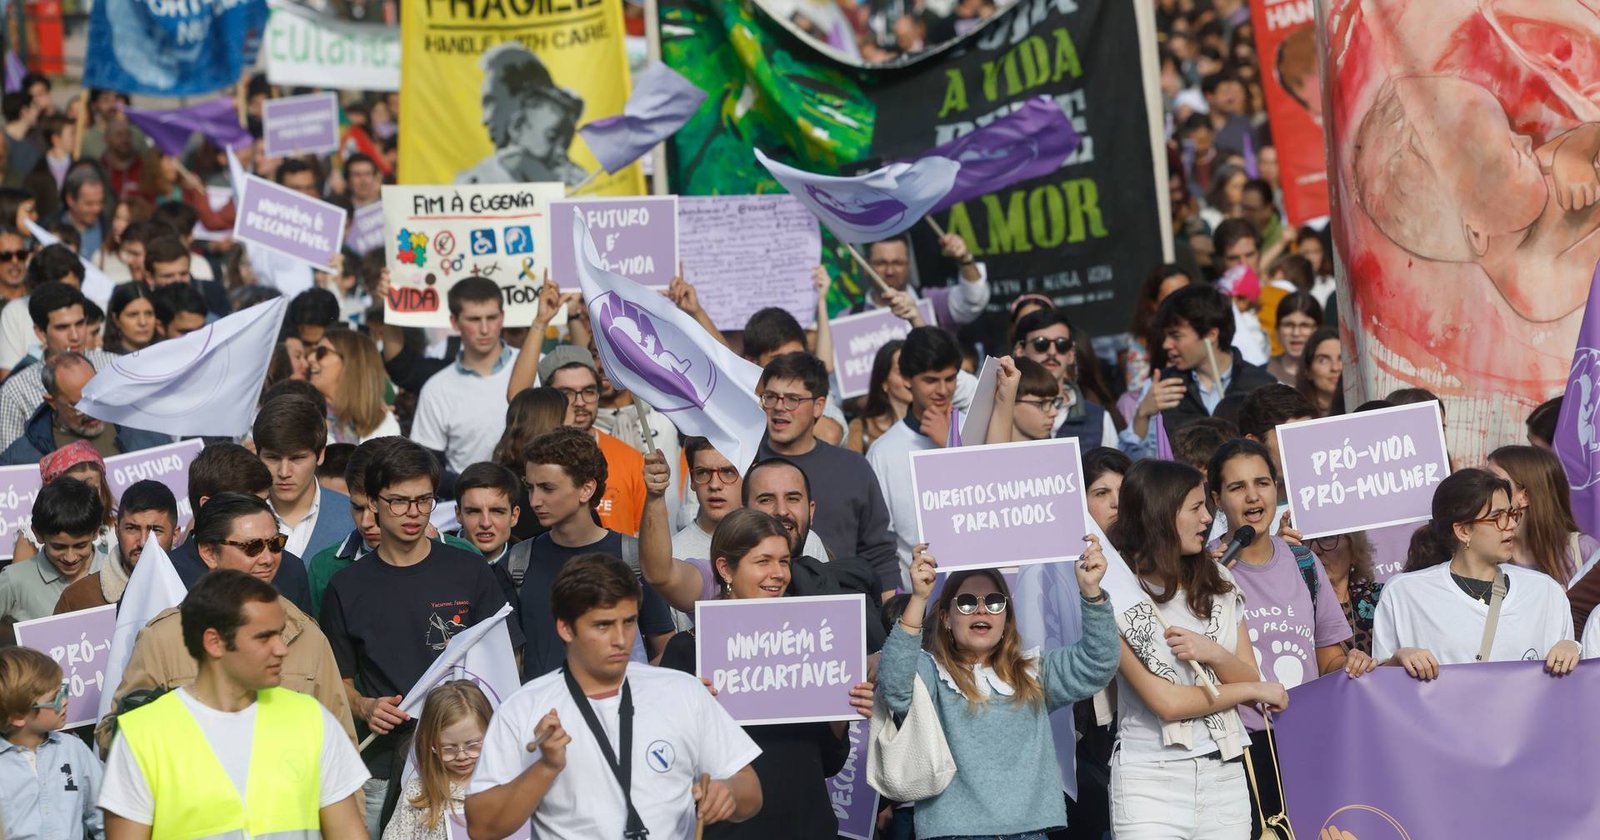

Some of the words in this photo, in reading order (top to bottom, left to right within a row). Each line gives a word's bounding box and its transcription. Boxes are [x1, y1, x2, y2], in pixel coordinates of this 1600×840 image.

[938, 69, 968, 118] A
[981, 27, 1083, 102] VIDA
[413, 195, 444, 215] FIM
[451, 191, 463, 212] À
[587, 207, 650, 229] FUTURO
[941, 178, 1108, 256] AMOR
[389, 288, 436, 309] VIDA
[114, 468, 126, 485] O
[124, 454, 184, 483] FUTURO
[1311, 434, 1417, 476] PRÓ-VIDA
[922, 482, 997, 511] DIREITOS
[999, 472, 1076, 501] HUMANOS
[1299, 463, 1440, 511] PRÓ-MULHER
[952, 509, 1000, 534] PARA
[1000, 502, 1056, 528] TODOS
[727, 621, 815, 661] NINGUÉM
[820, 618, 834, 652] É
[713, 654, 852, 695] DESCARTÁVEL
[60, 763, 79, 791] 1
